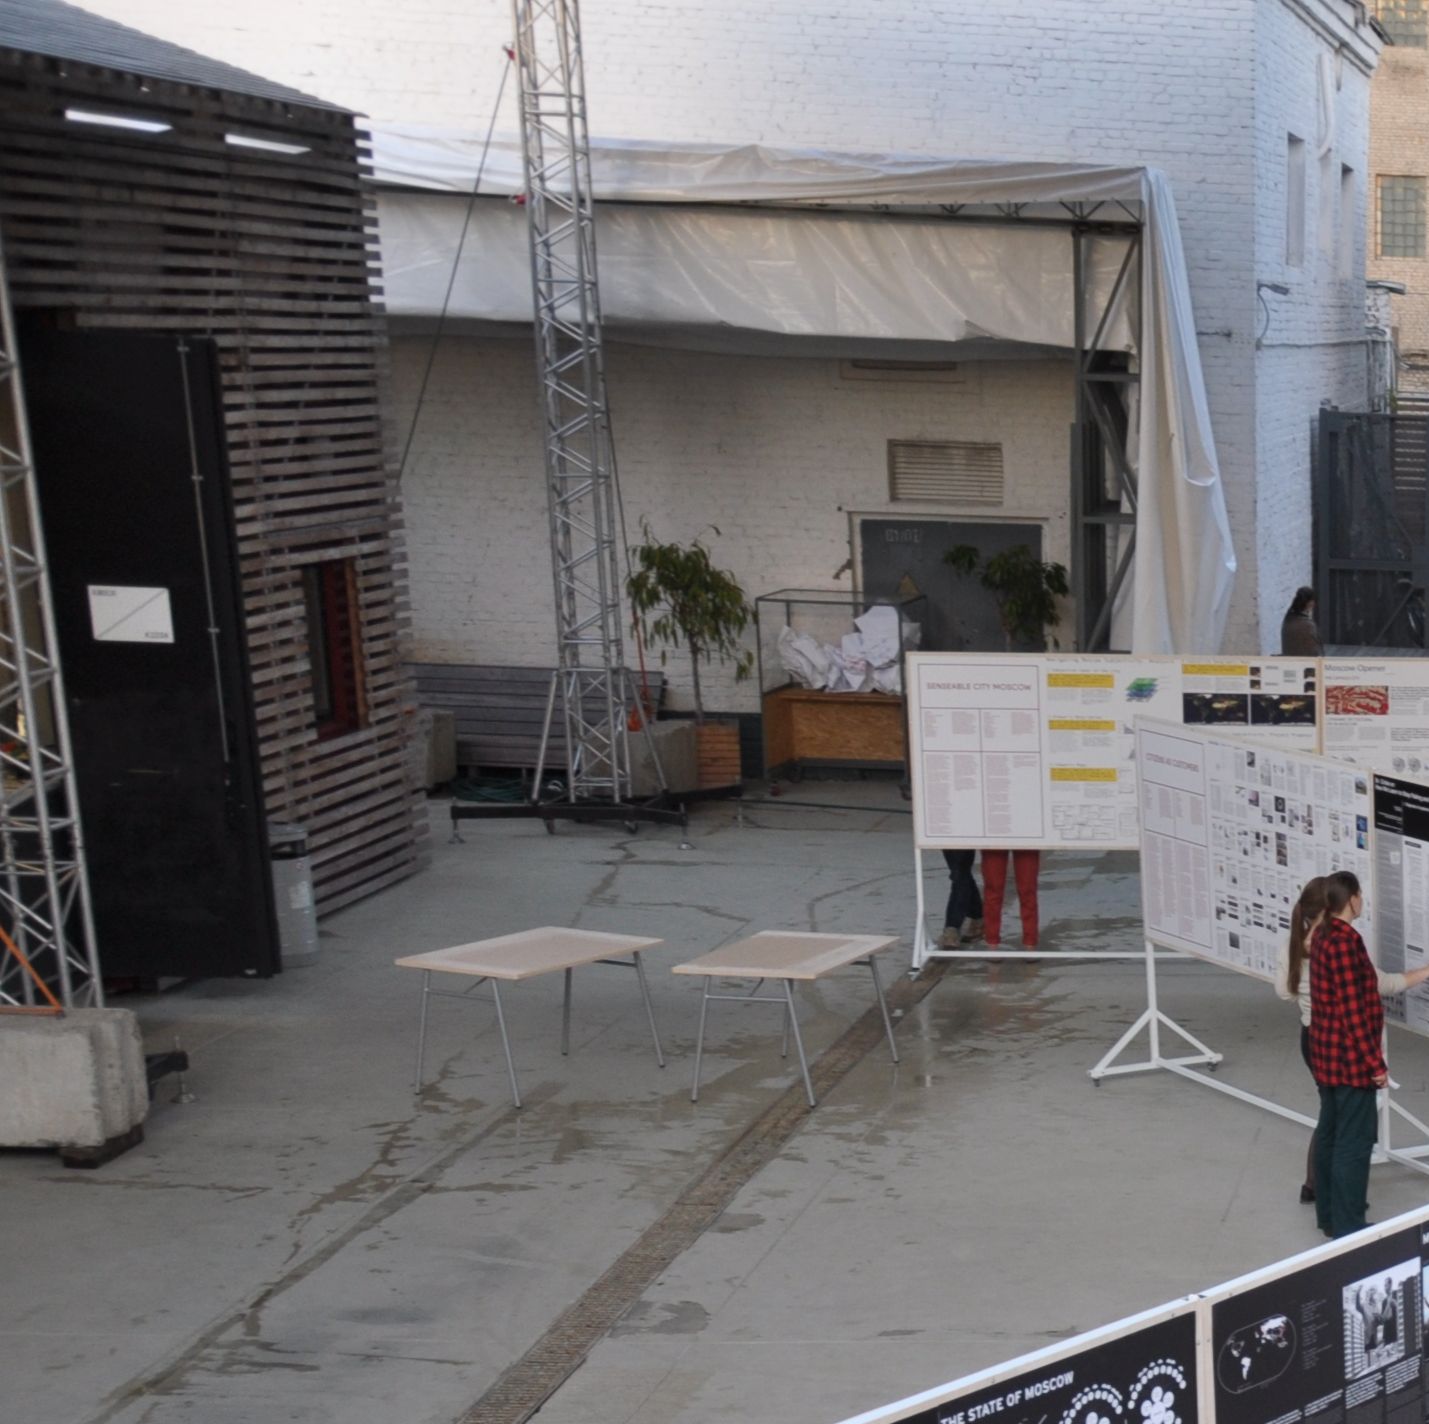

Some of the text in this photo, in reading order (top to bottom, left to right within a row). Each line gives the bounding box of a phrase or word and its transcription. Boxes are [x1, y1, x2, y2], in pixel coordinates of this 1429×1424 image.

[973, 682, 991, 690] CITY
[992, 682, 1031, 691] MOSCOW
[967, 1397, 1004, 1422] STATE
[1006, 1390, 1022, 1407] OF
[1024, 1370, 1074, 1400] MOSCOW
